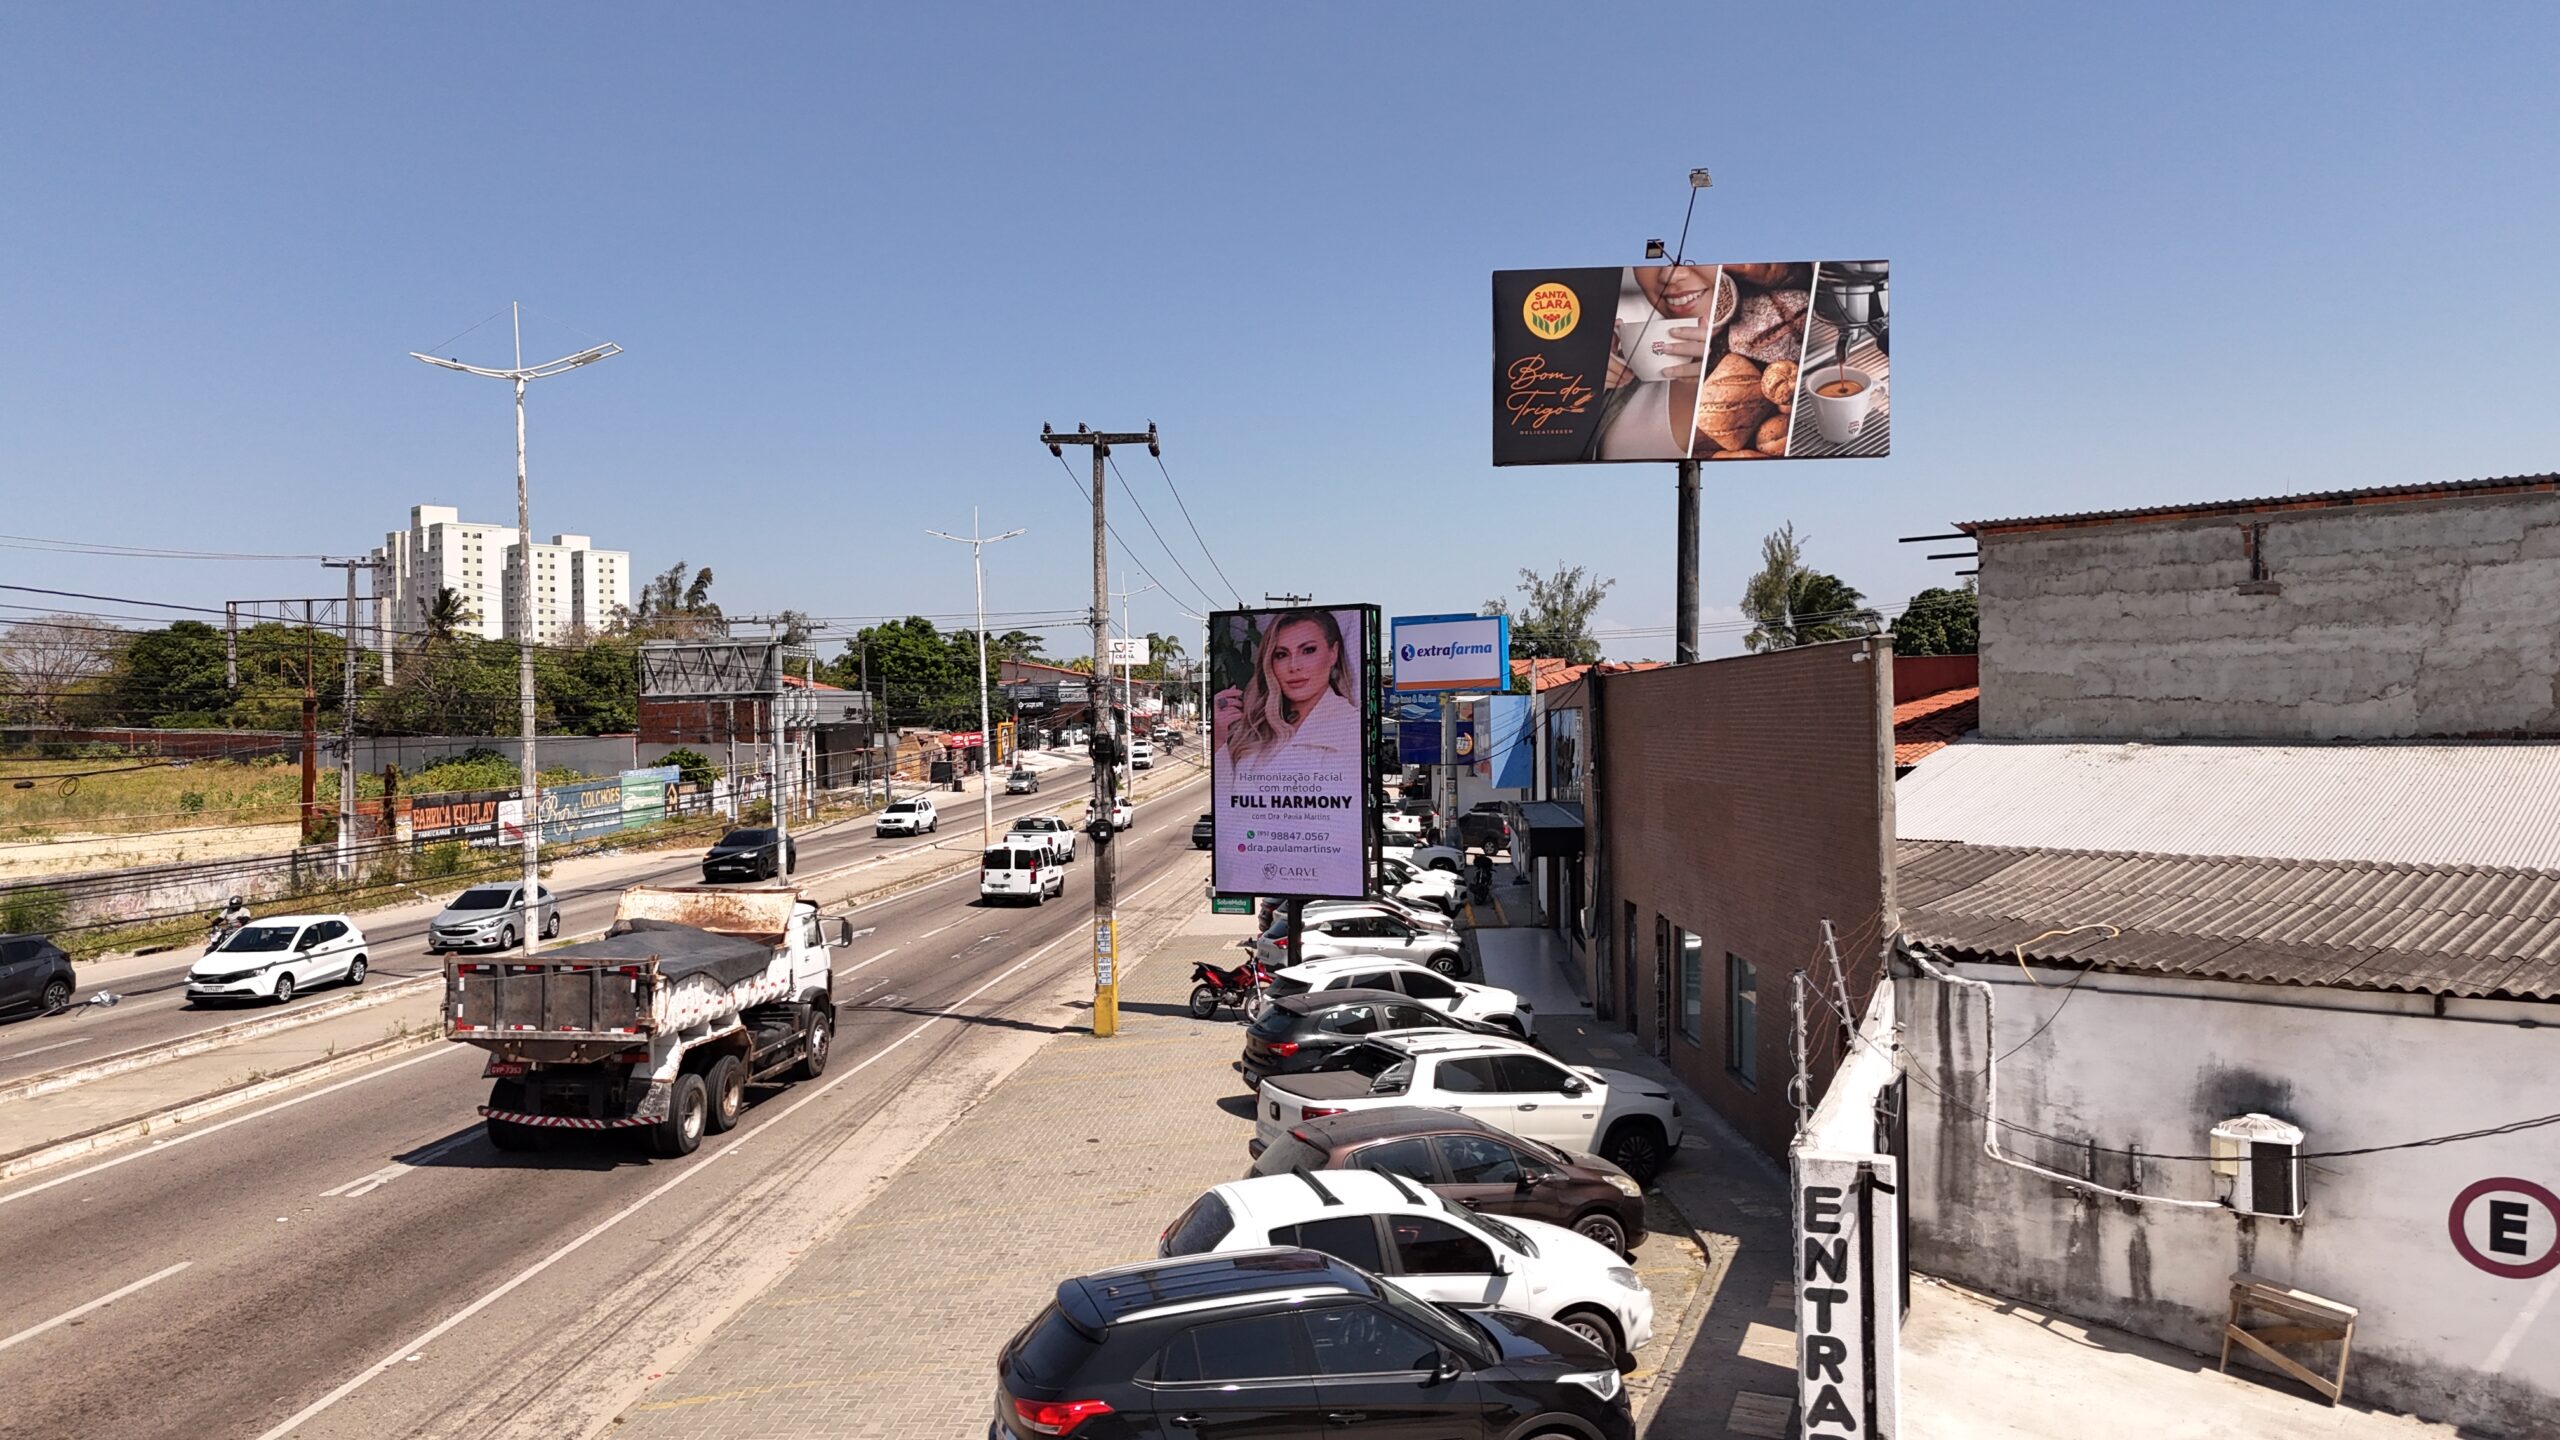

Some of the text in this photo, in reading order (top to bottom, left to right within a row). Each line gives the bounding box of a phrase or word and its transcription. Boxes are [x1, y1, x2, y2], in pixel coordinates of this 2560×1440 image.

[1535, 290, 1568, 300] SANTA
[1531, 299, 1572, 311] CLARA
[1508, 353, 1574, 390] Bom
[1560, 374, 1592, 402] do
[1506, 389, 1565, 428] Trigo
[1417, 641, 1492, 659] extrafarma
[1239, 772, 1343, 784] Harmonização Facial
[581, 786, 621, 809] COLCHÕES
[1230, 795, 1353, 809] FULL HARMONY
[412, 805, 451, 830] FABRICA
[471, 801, 497, 824] PLAY
[1304, 813, 1330, 821] Martins
[1270, 832, 1330, 841] 98847.0567
[1247, 843, 1342, 854] dra.paulamartinsw
[1279, 866, 1319, 877] CARVE
[2489, 1200, 2529, 1256] E
[1803, 1186, 1857, 1440] ENTRA
